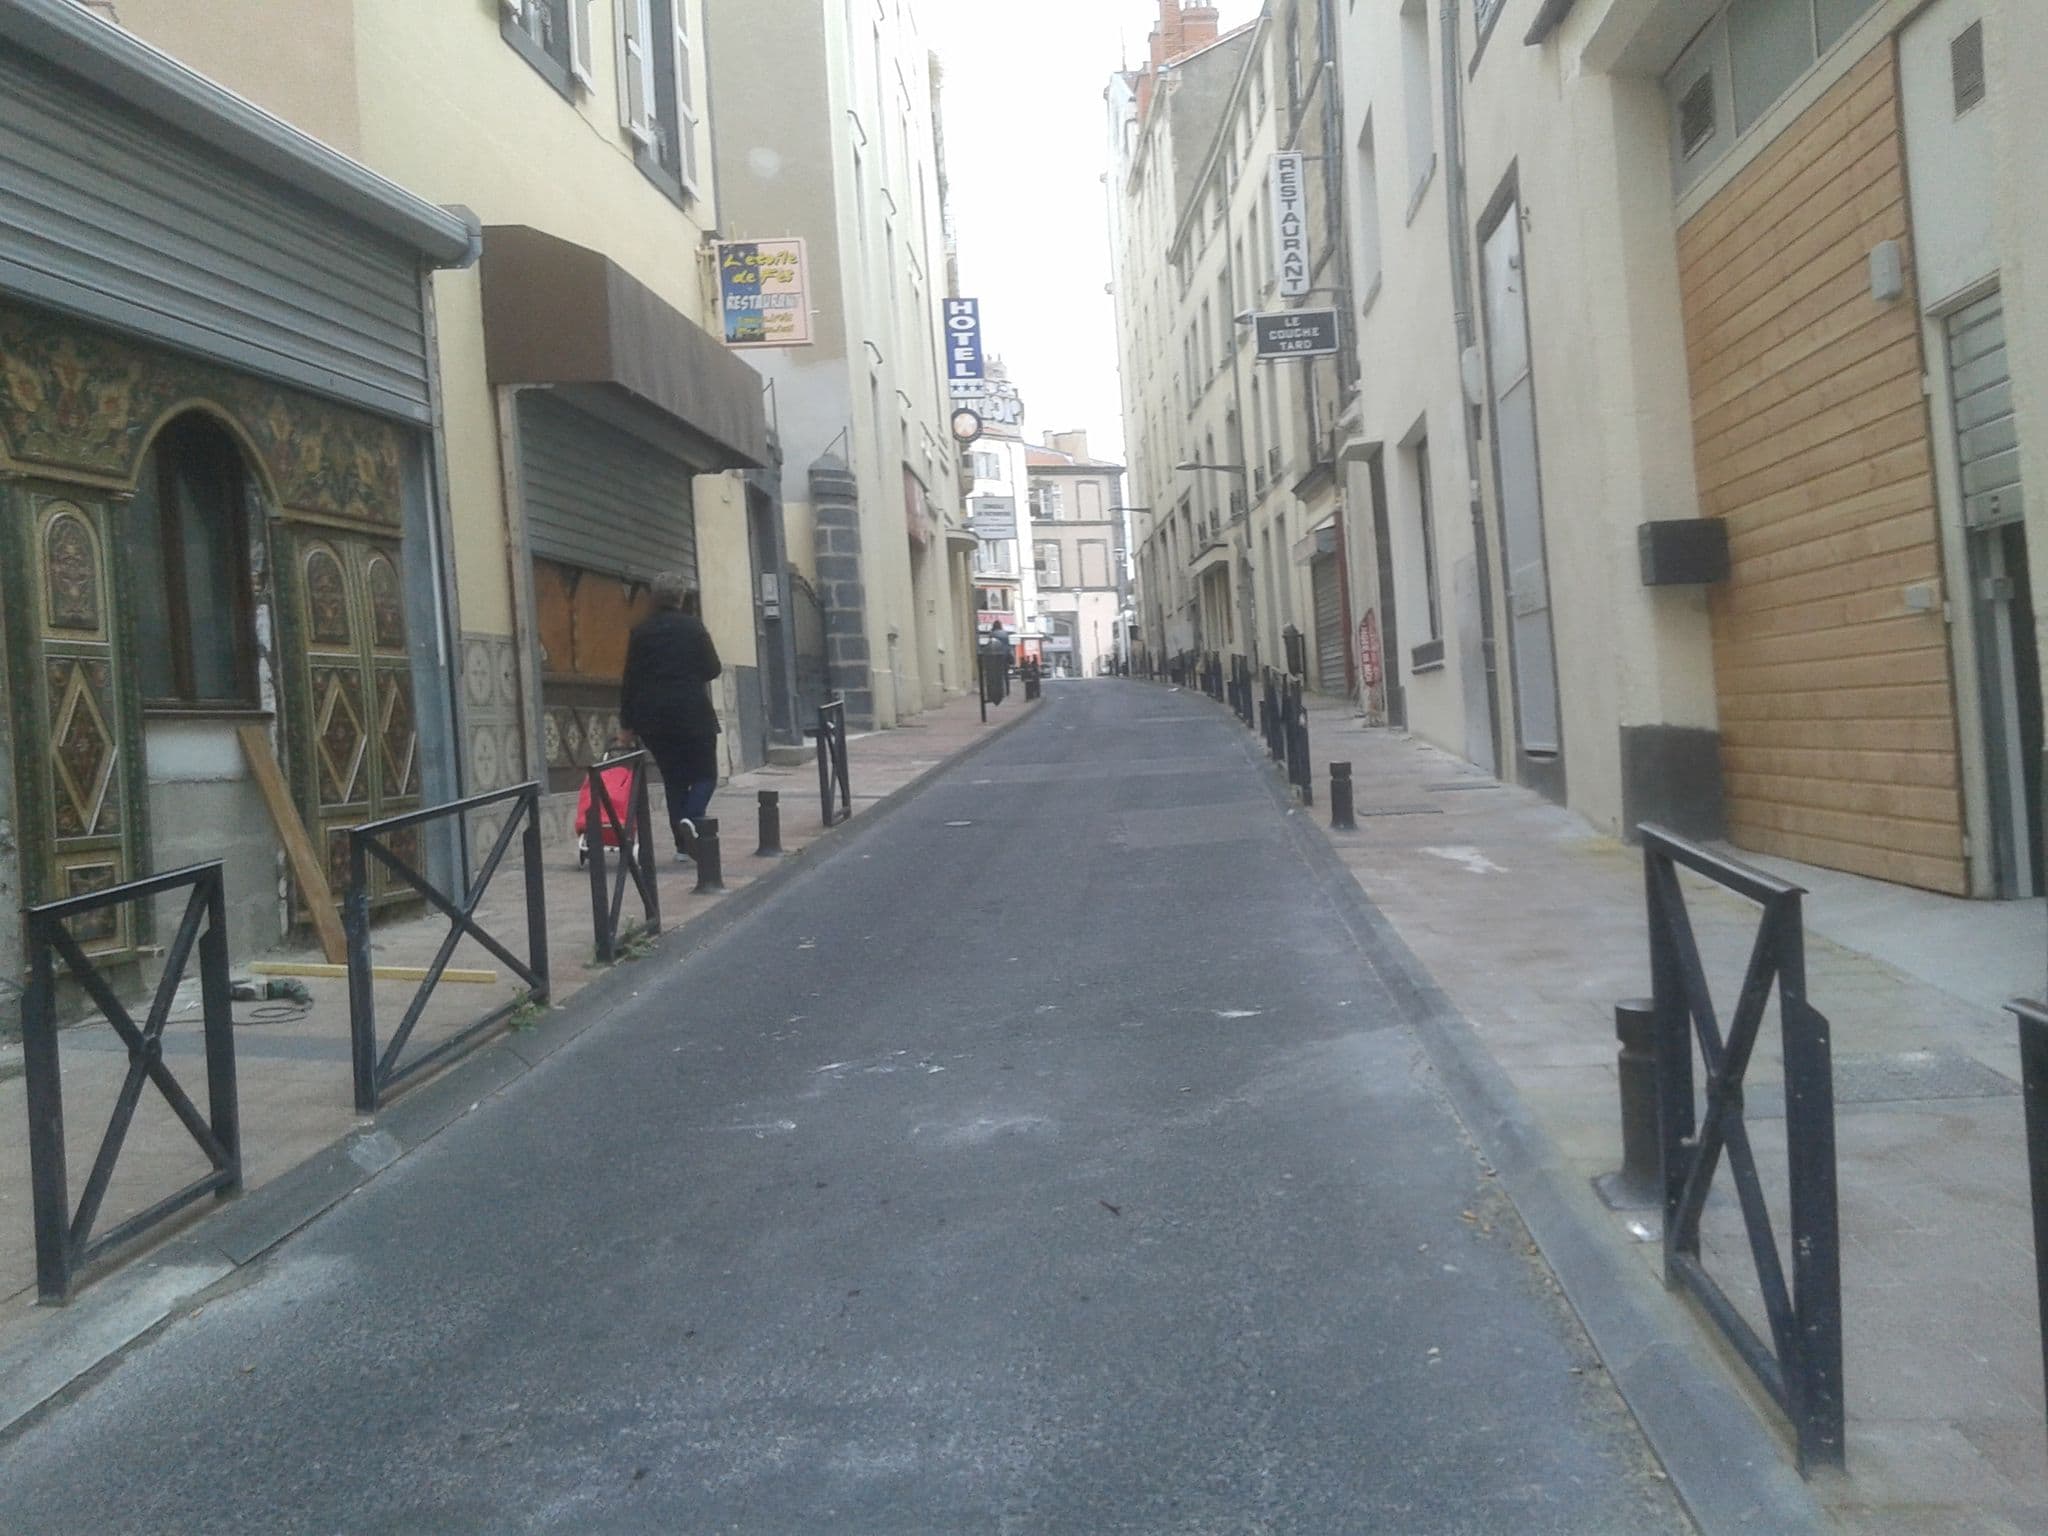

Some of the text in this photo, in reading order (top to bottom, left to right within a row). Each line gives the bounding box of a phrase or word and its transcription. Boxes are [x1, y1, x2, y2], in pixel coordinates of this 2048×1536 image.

[1278, 158, 1303, 291] RESTAURANT
[732, 270, 756, 285] de
[1284, 317, 1302, 328] LE
[948, 301, 976, 377] HOTEL
[1268, 327, 1320, 341] COUCHE
[1279, 340, 1313, 351] TARD
